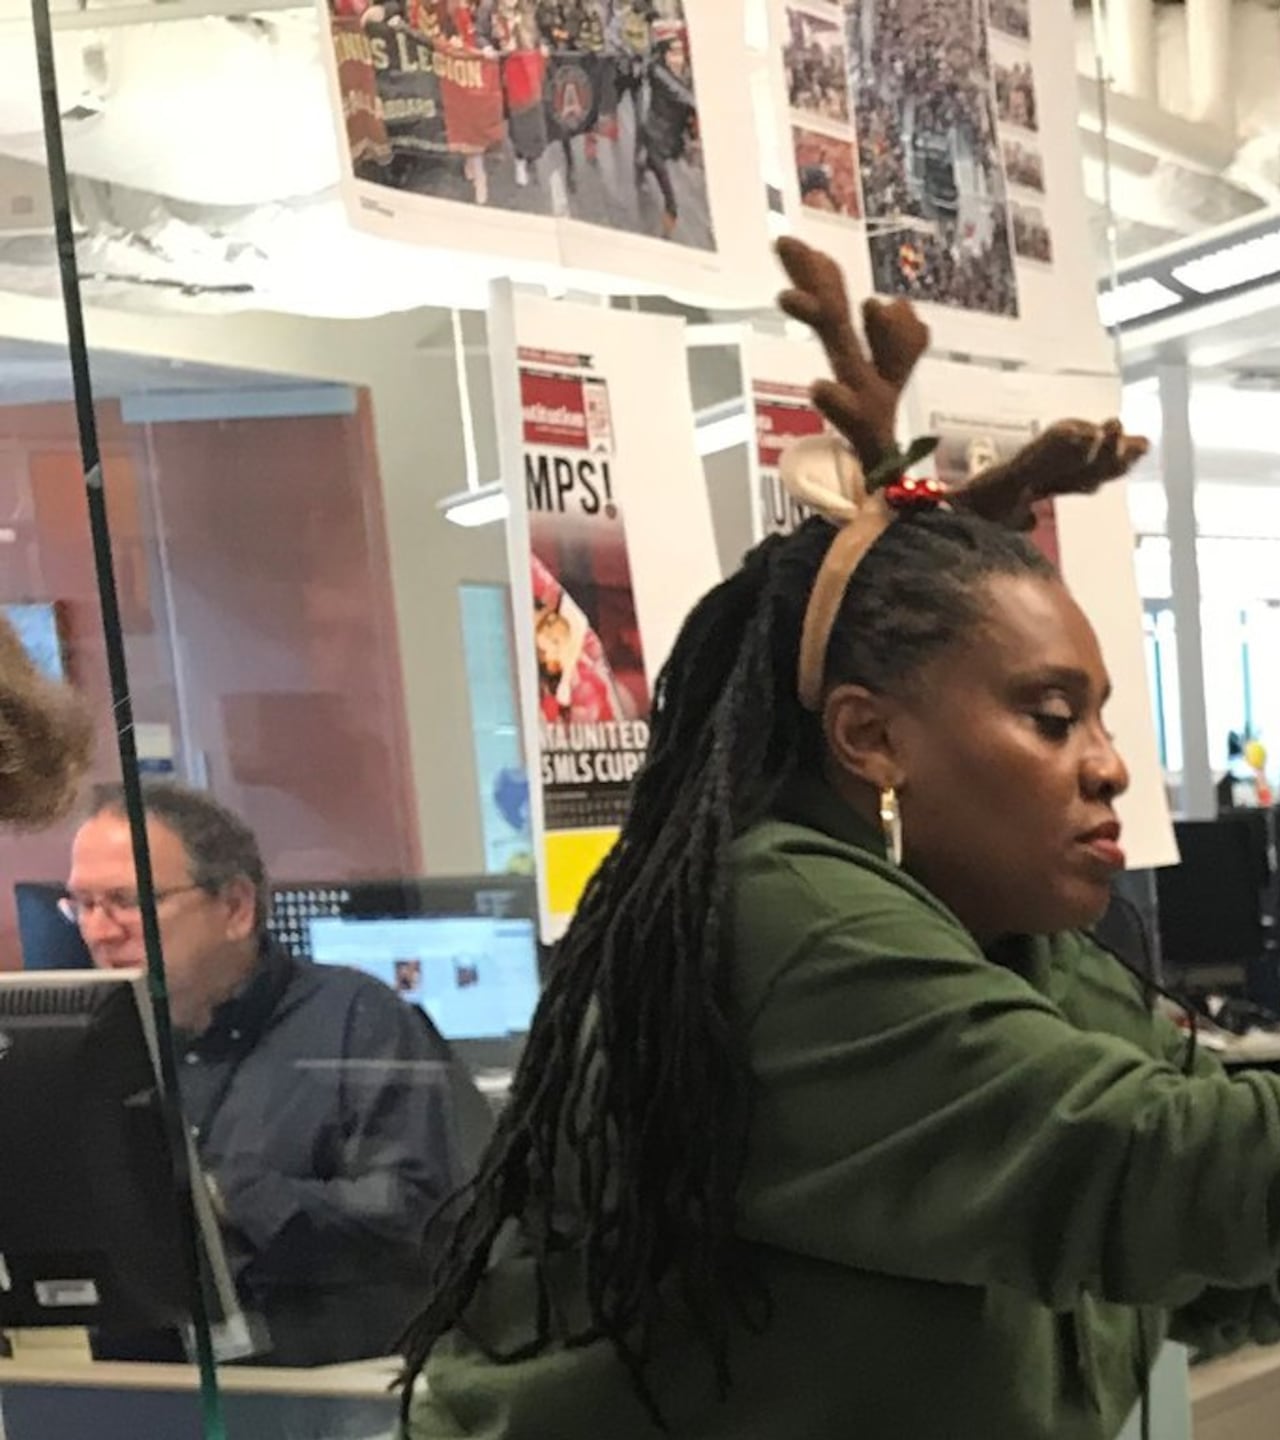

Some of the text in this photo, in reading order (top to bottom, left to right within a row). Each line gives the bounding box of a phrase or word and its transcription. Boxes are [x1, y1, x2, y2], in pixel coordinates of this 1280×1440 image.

[396, 31, 484, 89] LEGION
[525, 453, 617, 519] MPS!
[570, 720, 650, 750] UNITED
[554, 752, 593, 783] MLS
